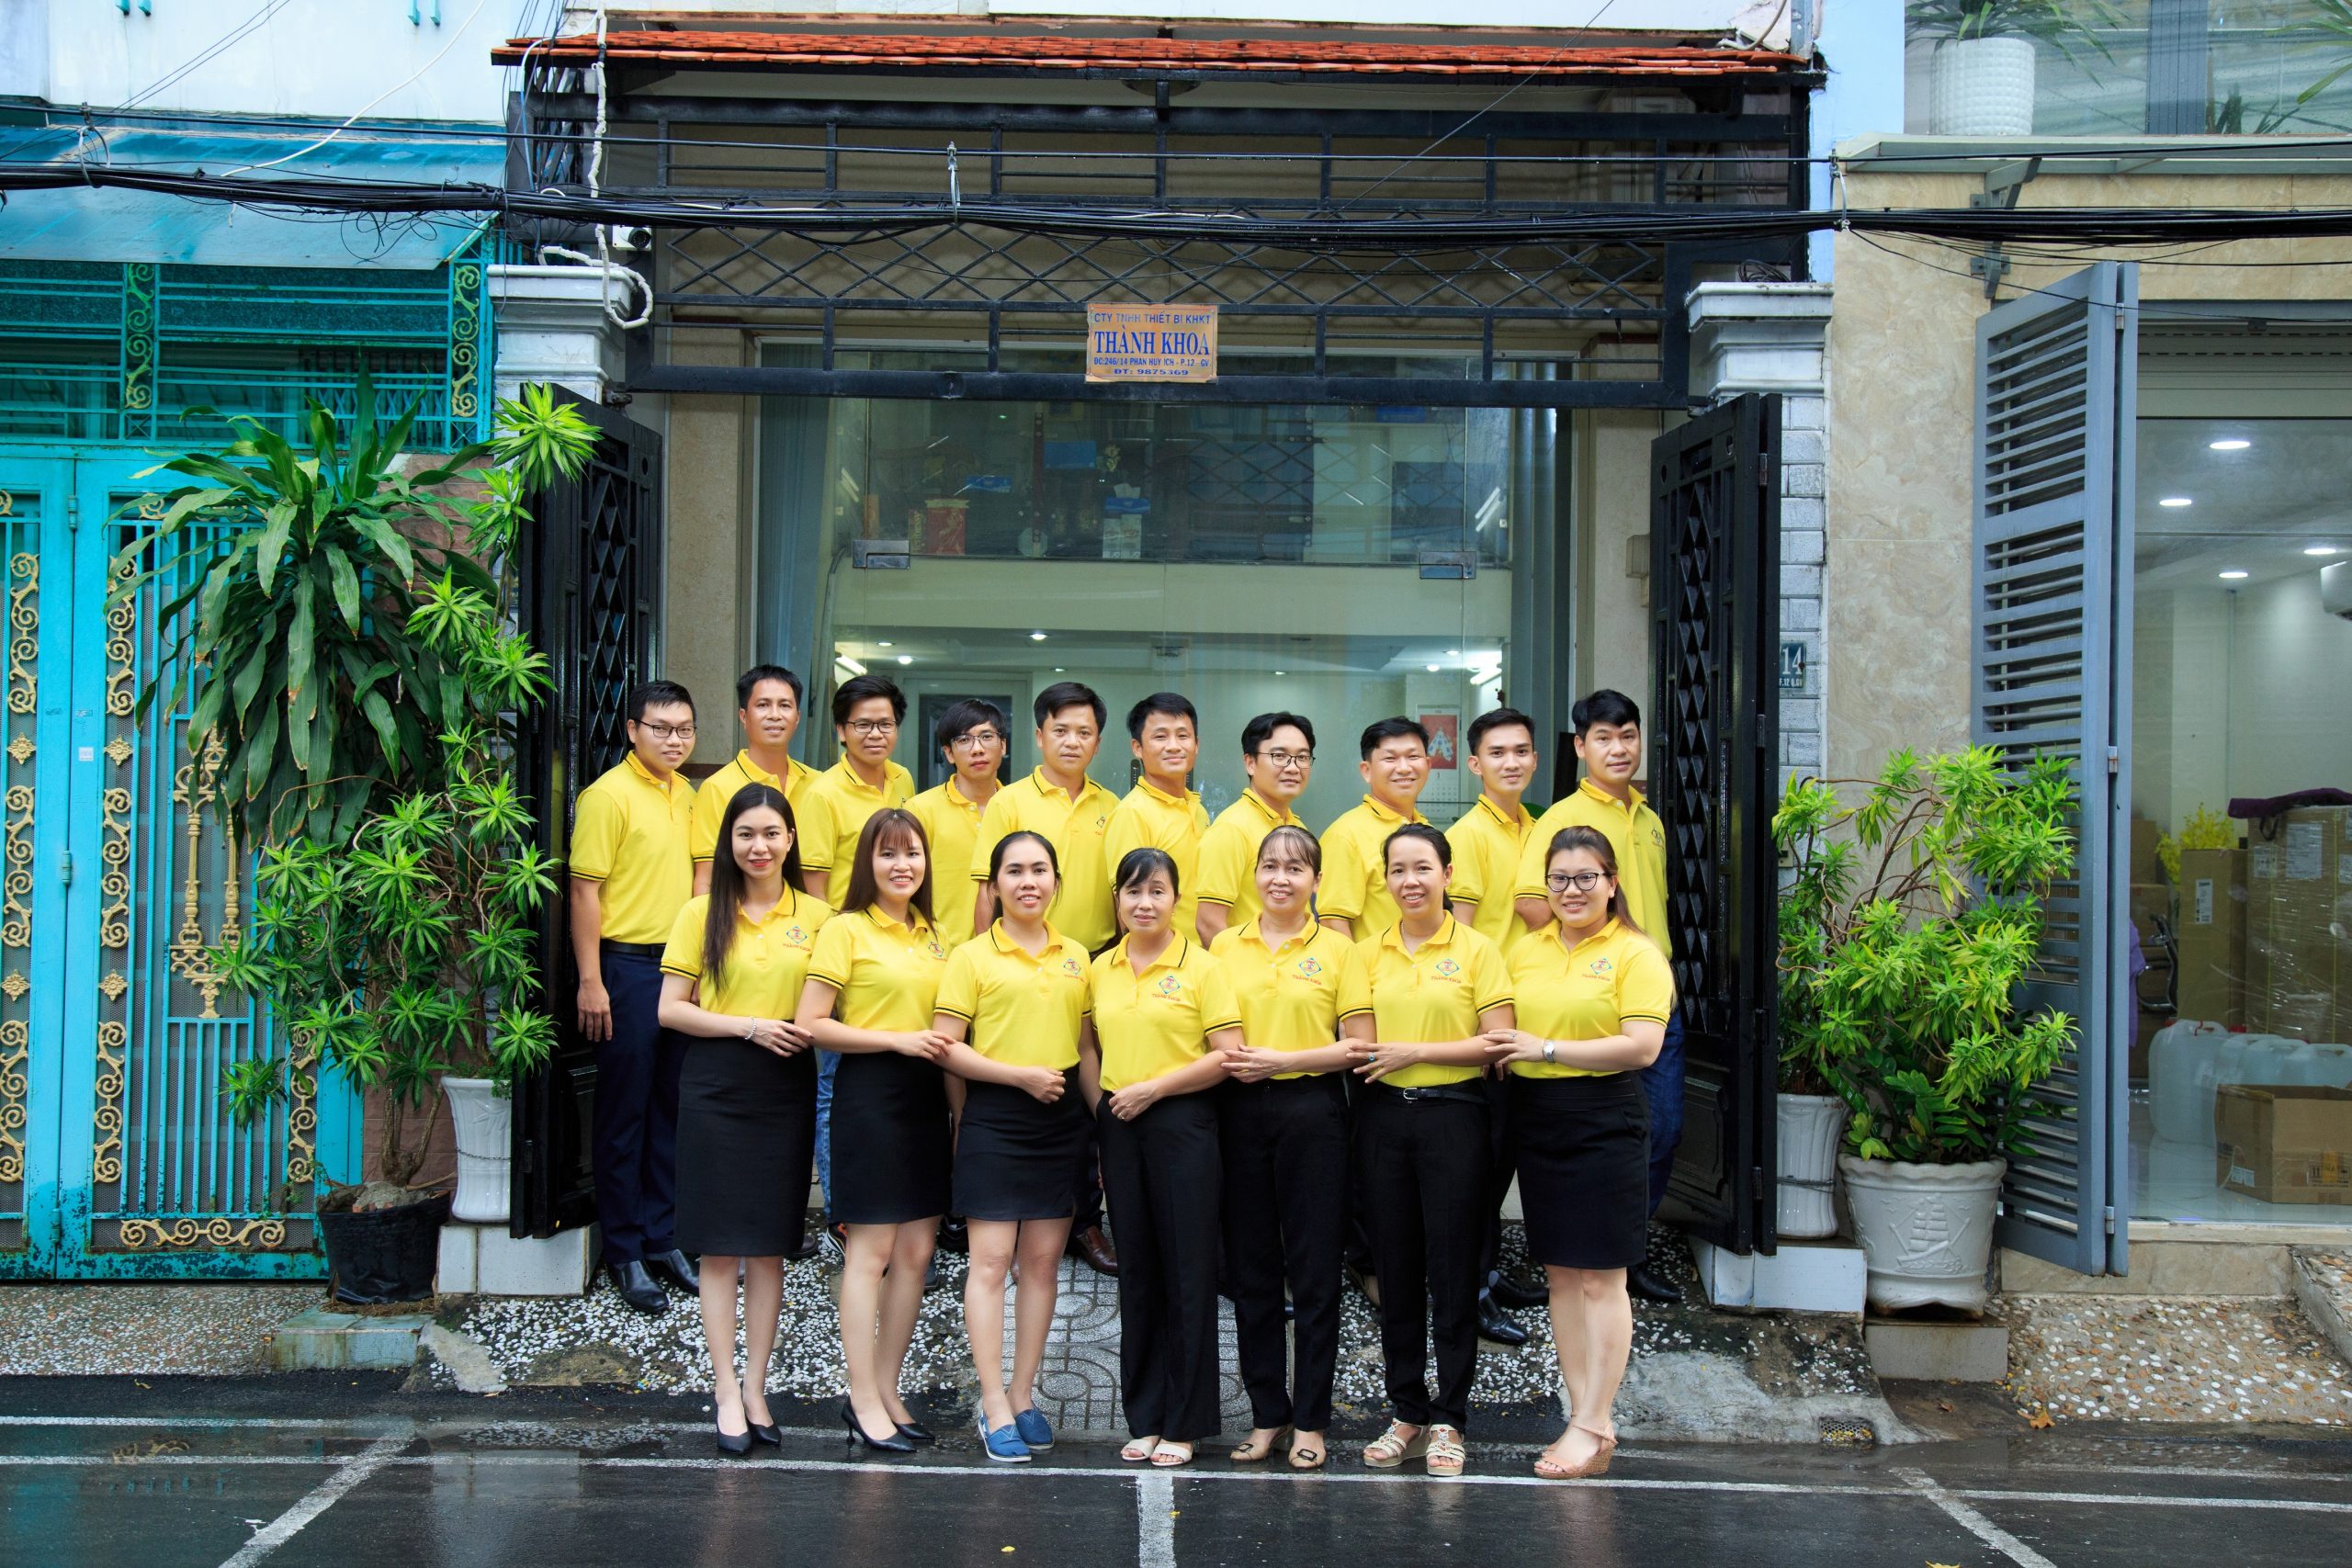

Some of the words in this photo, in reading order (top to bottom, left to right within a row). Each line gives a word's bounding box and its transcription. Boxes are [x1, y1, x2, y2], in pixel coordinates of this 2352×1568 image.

[1094, 313, 1113, 322] CTY
[1115, 313, 1141, 323] TNHH
[1145, 311, 1170, 324] THIẾT
[1185, 314, 1211, 324] KHKT
[1094, 324, 1156, 355] THÀNH
[1161, 332, 1210, 355] KHOA
[1148, 358, 1161, 367] HUY
